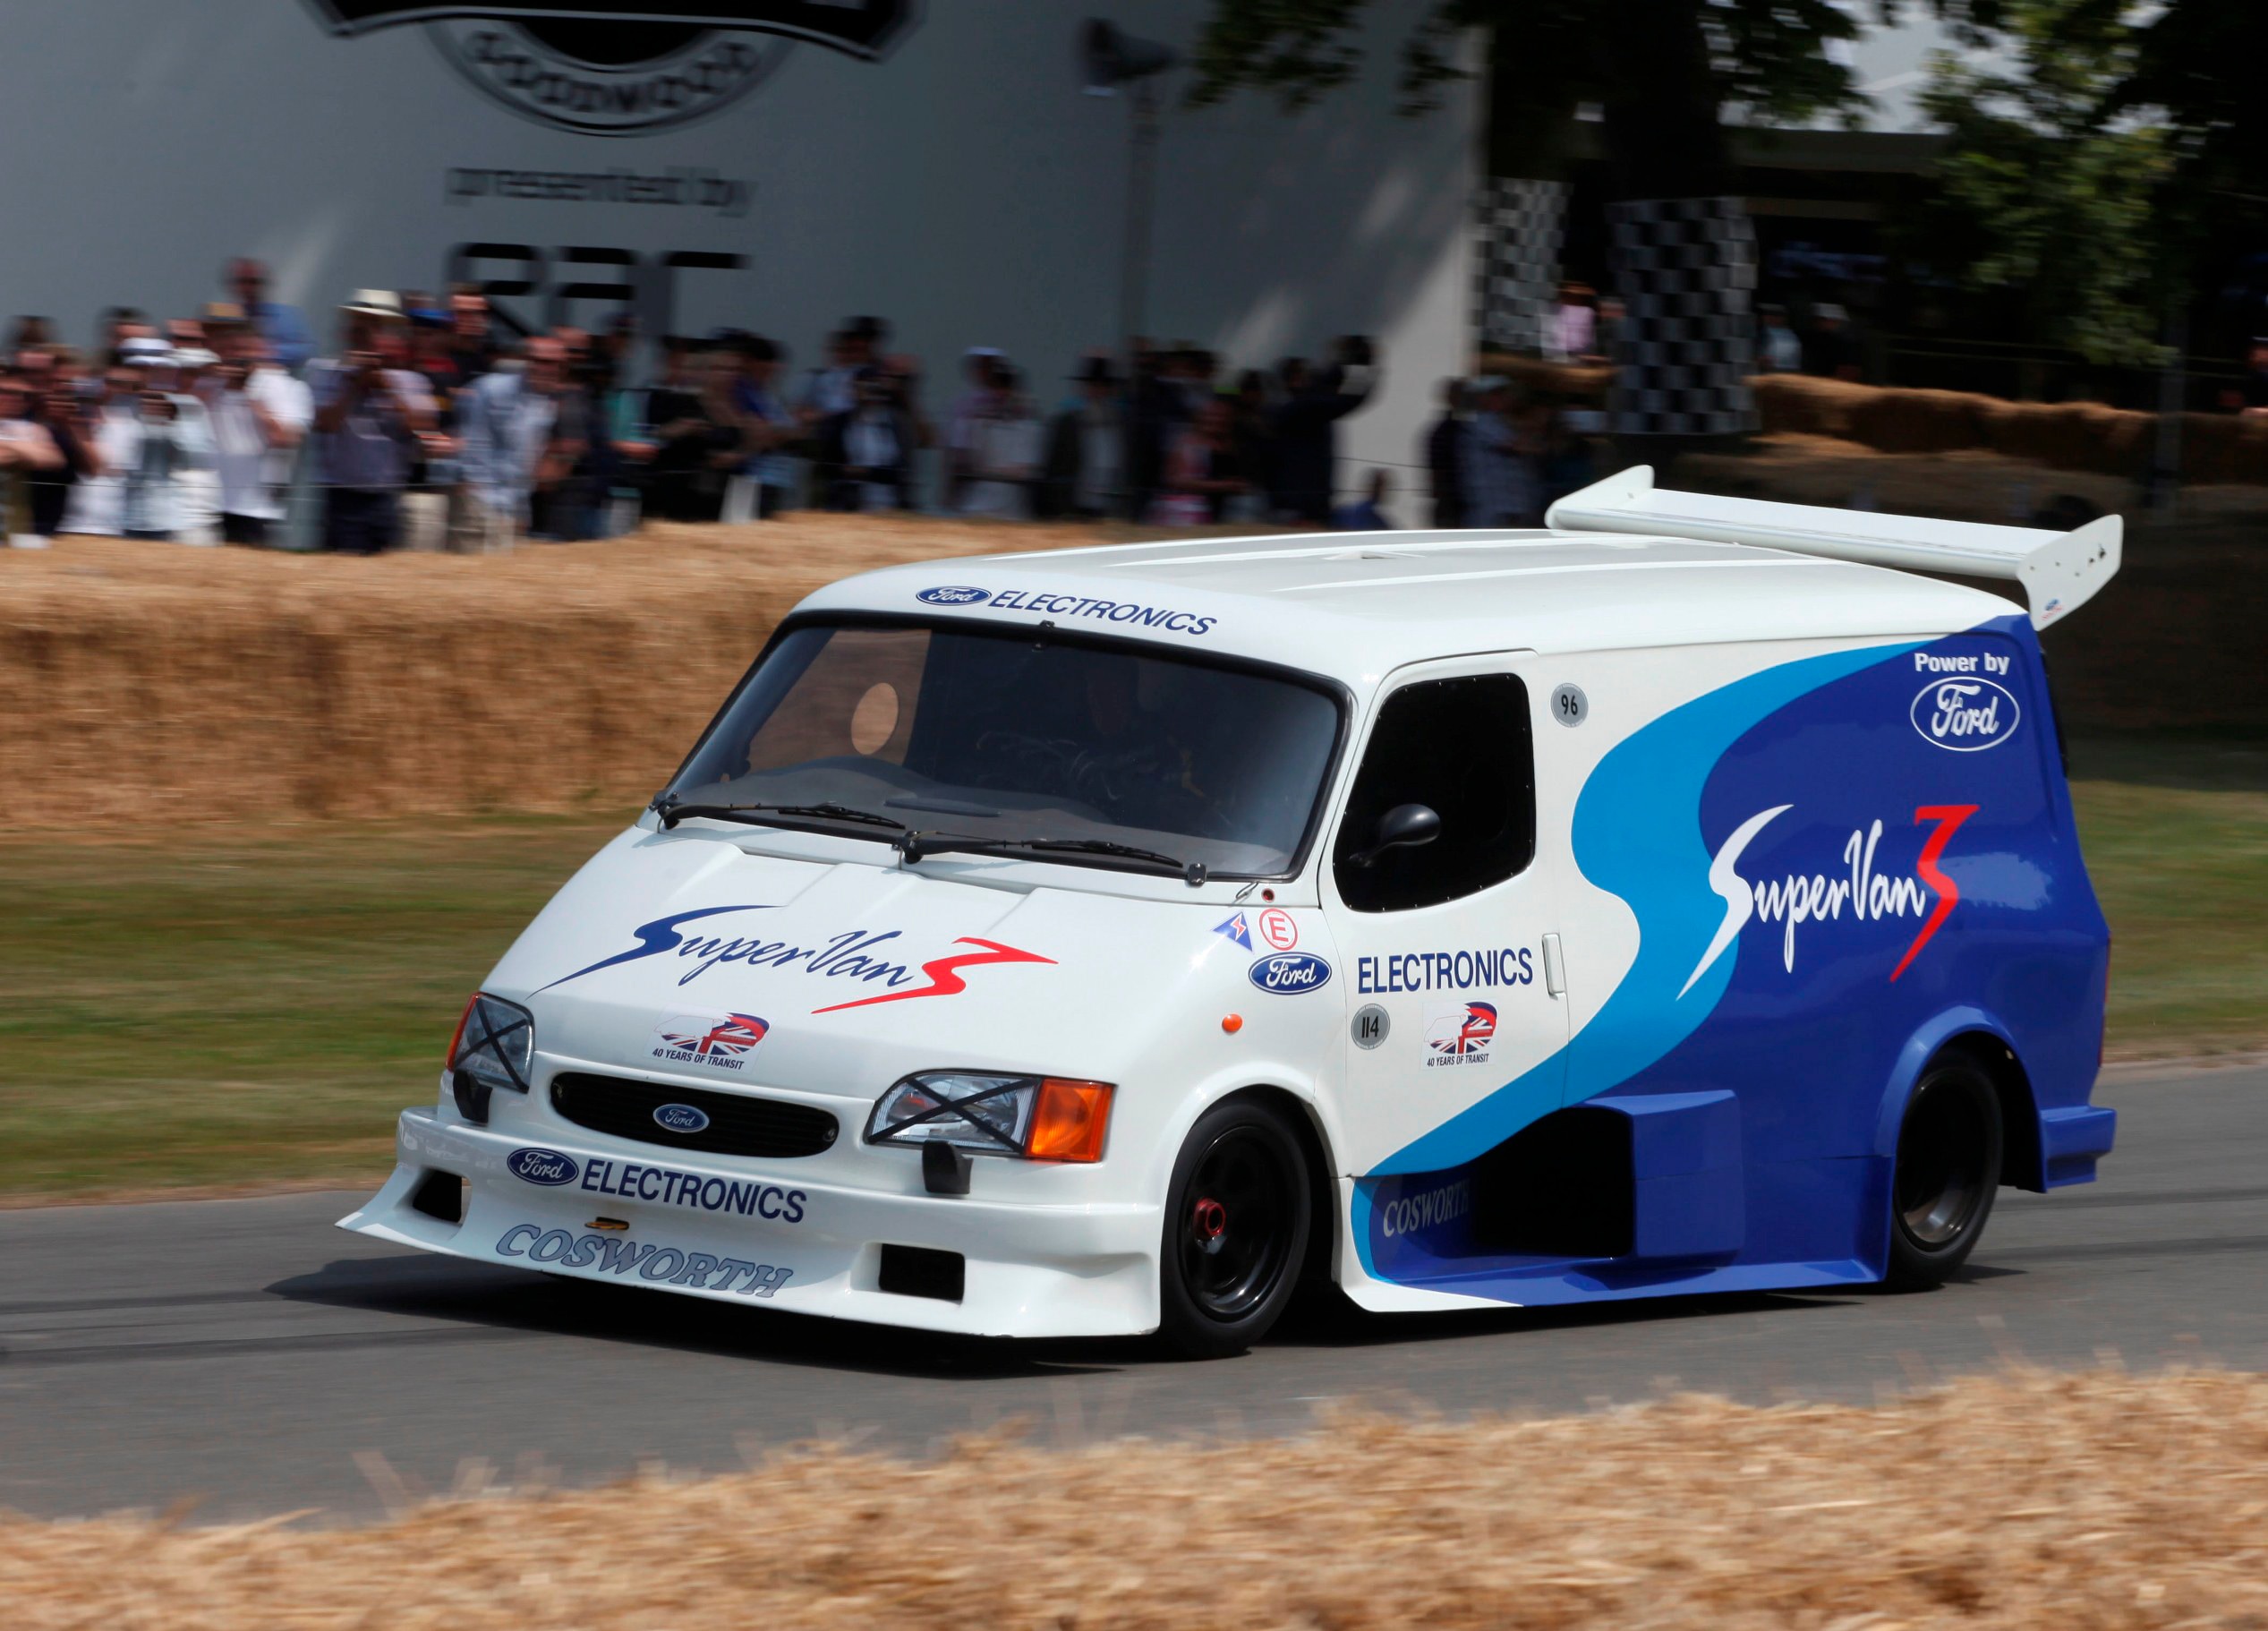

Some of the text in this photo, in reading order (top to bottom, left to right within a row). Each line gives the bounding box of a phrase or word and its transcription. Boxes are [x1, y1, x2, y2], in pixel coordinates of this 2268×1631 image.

[988, 590, 1218, 636] ELECTRONICS
[1914, 652, 2010, 675] Power by
[1561, 694, 1578, 716] 96
[1931, 684, 1999, 738] Ford
[1268, 917, 1290, 943] E
[1357, 947, 1534, 995] ELECTRONICS
[1361, 1015, 1380, 1038] 114
[652, 1047, 745, 1071] 40 YEARS OF TRANSIT
[1427, 1053, 1489, 1067] 40 YEARS OF TRANSIT
[518, 1149, 807, 1224] Ford ELECTRONICS
[1383, 1178, 1471, 1238] COSWORTH
[495, 1223, 794, 1299] COSWORTH
